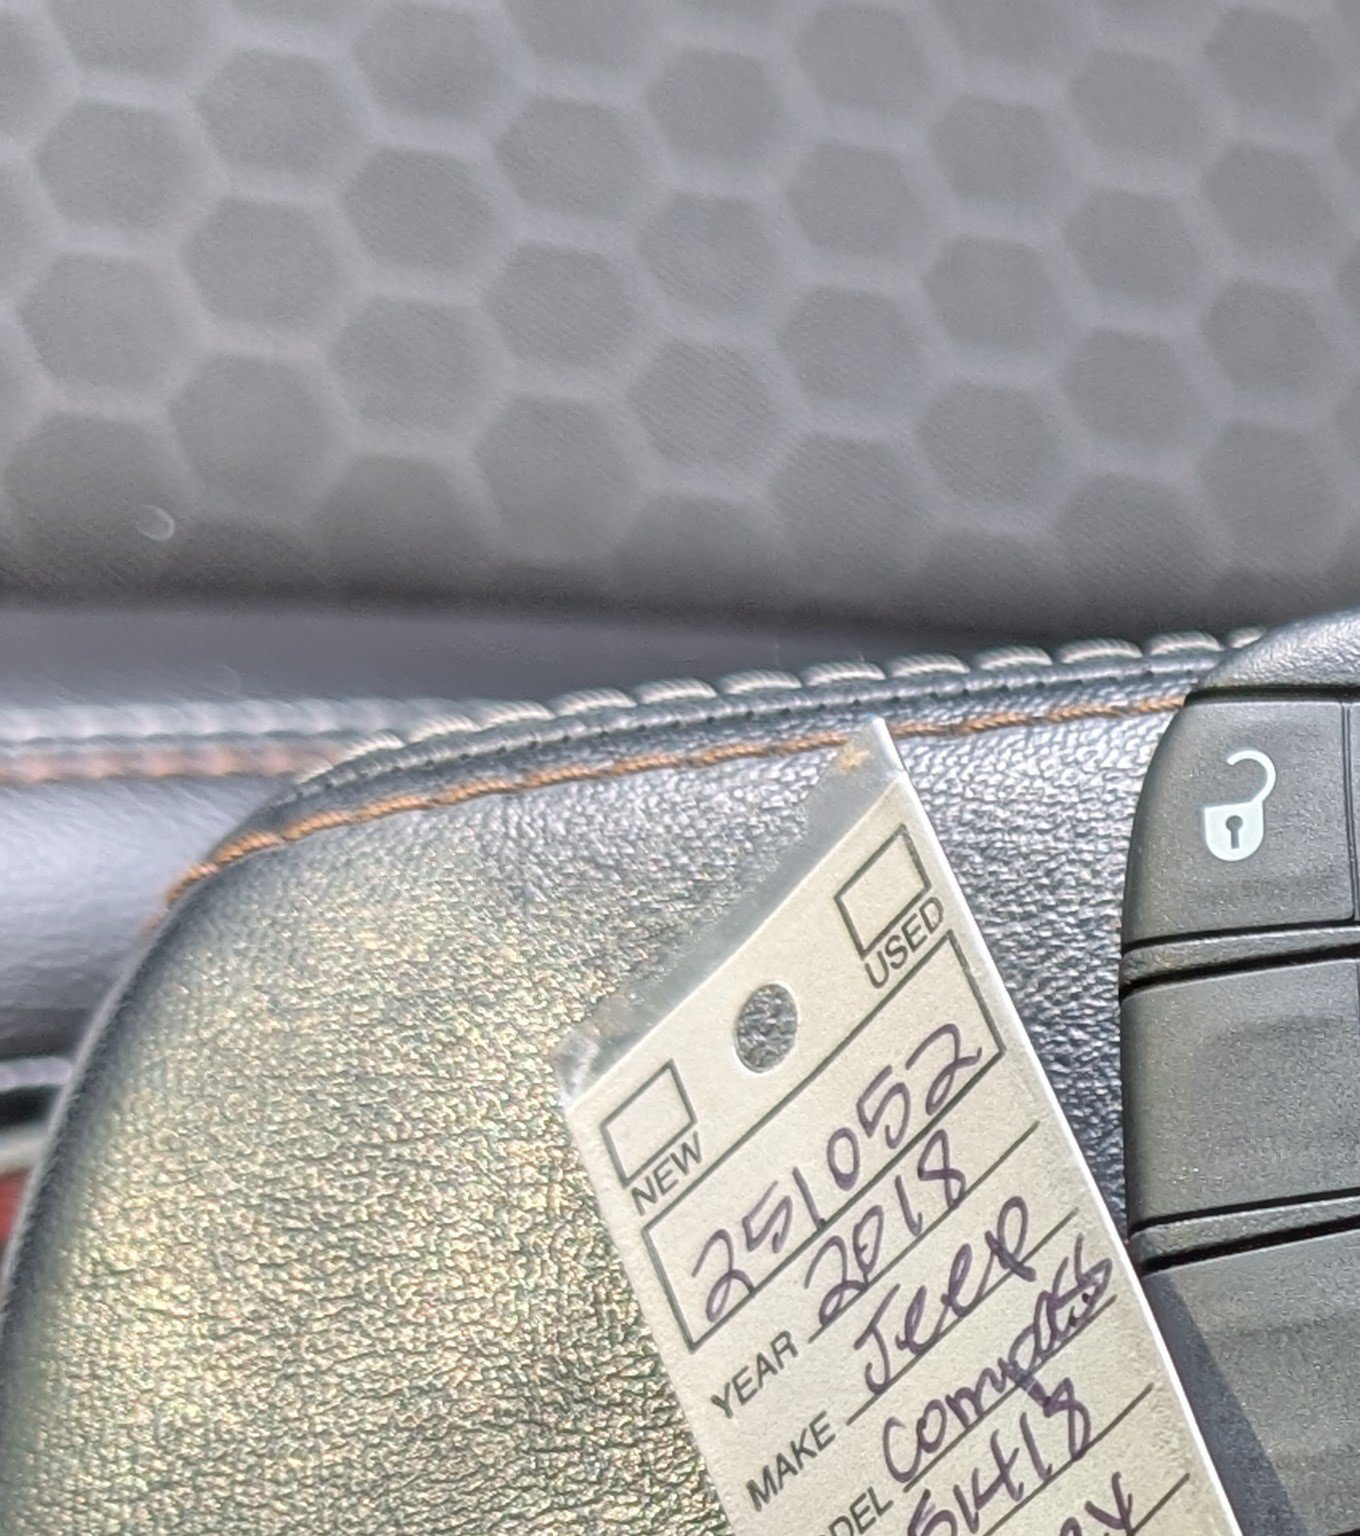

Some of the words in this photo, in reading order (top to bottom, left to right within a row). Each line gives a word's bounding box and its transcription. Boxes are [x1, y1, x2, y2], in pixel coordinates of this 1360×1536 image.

[632, 1132, 704, 1214] NEW
[864, 897, 945, 989] USED
[691, 1023, 983, 1324] 251052
[804, 1130, 966, 1328] 2018
[712, 1331, 798, 1420] YEAR
[853, 1195, 1037, 1394] Jeep
[746, 1411, 837, 1511] MAKE
